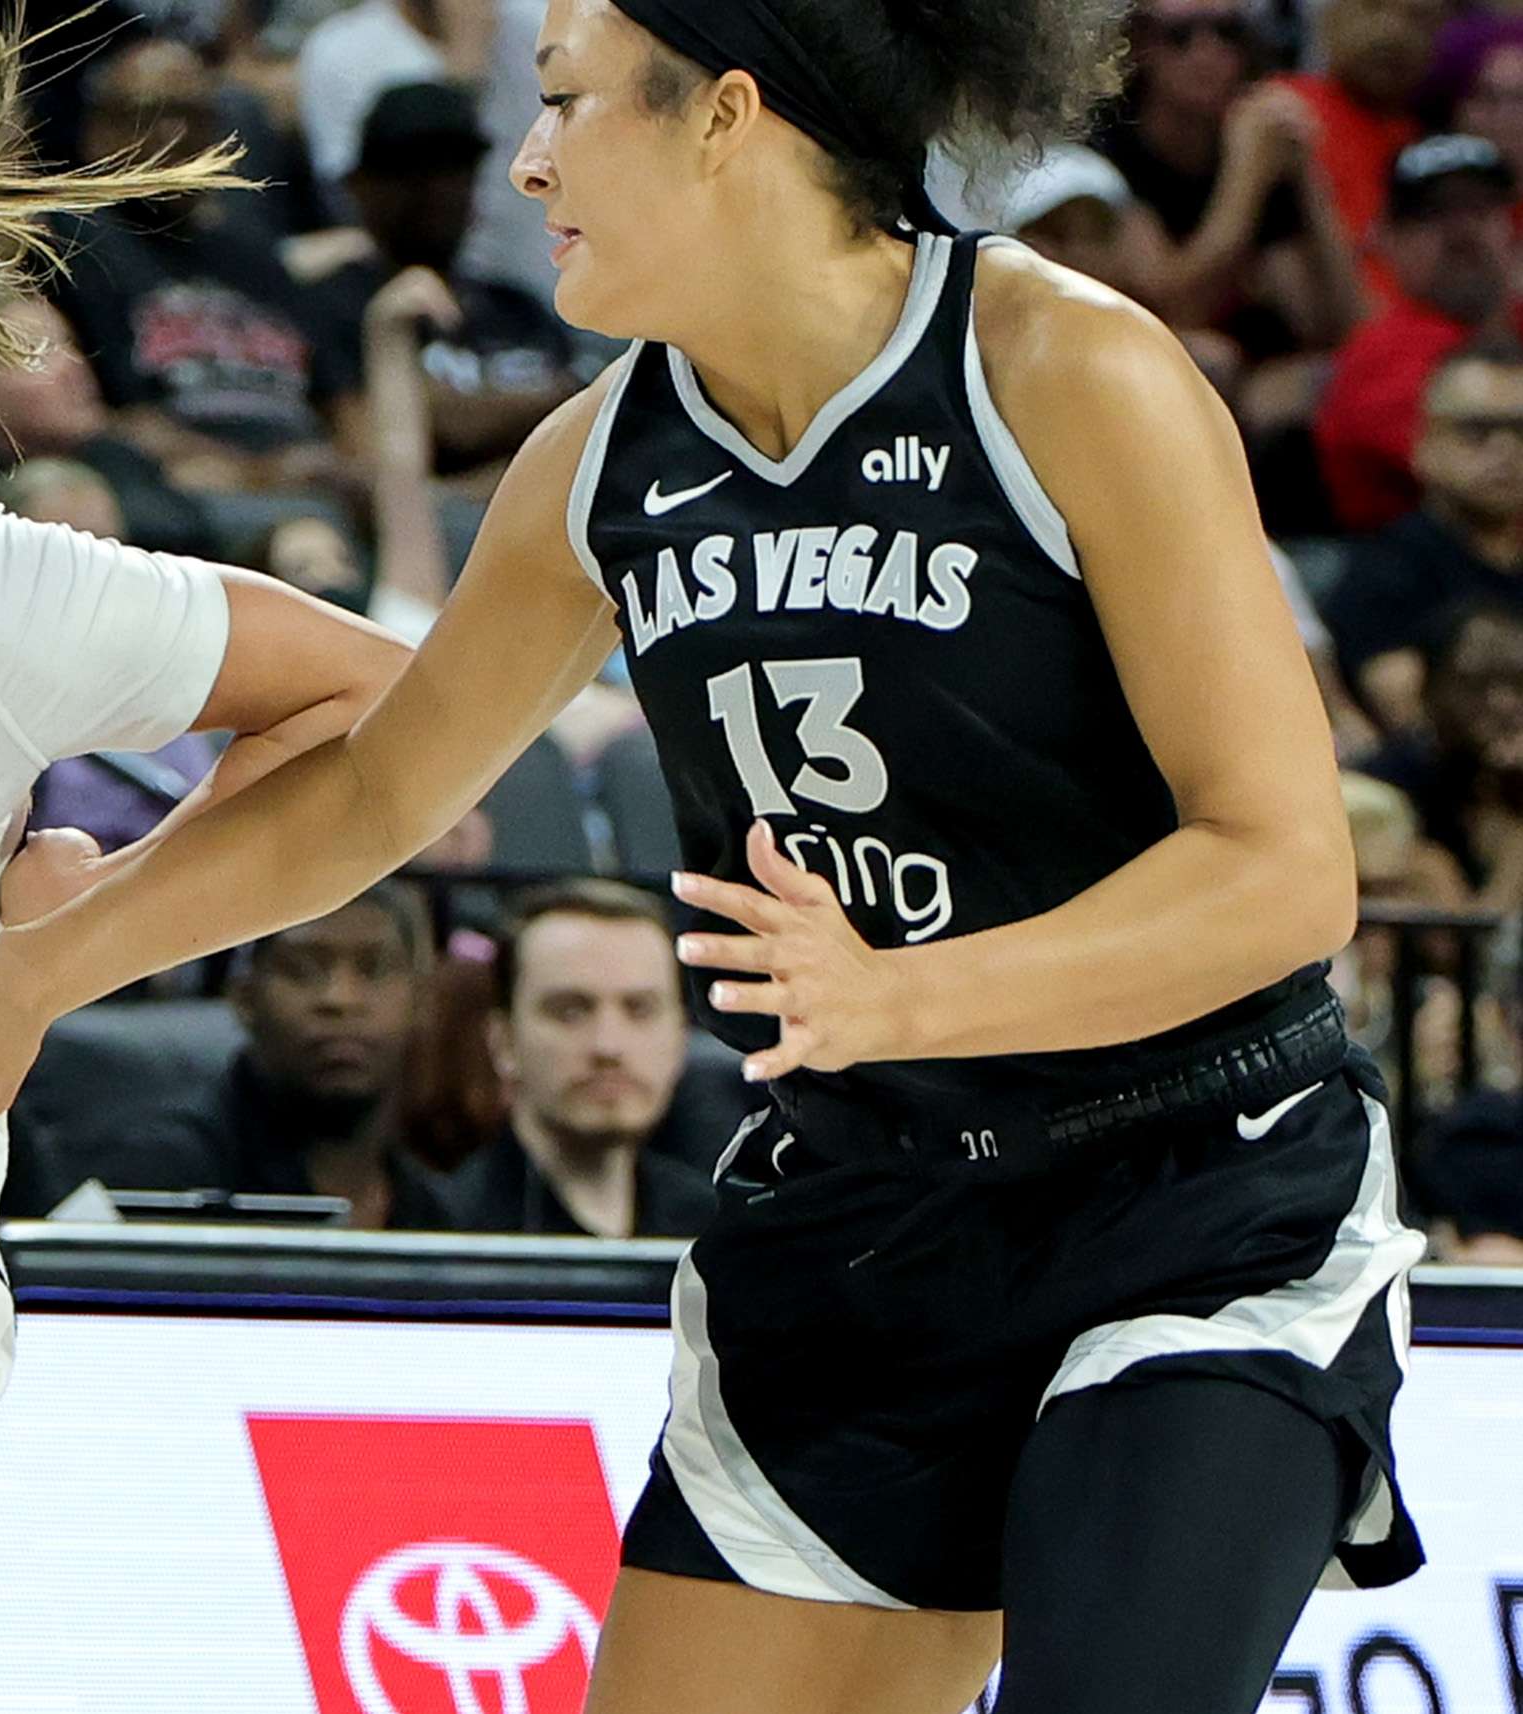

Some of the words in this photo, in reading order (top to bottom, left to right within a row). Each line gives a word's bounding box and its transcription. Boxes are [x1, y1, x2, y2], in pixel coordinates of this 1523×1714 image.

[861, 436, 951, 491] ally
[620, 534, 738, 657] LAS
[752, 524, 978, 632] VEGAS
[706, 656, 889, 816] 13
[784, 823, 953, 943] ring
